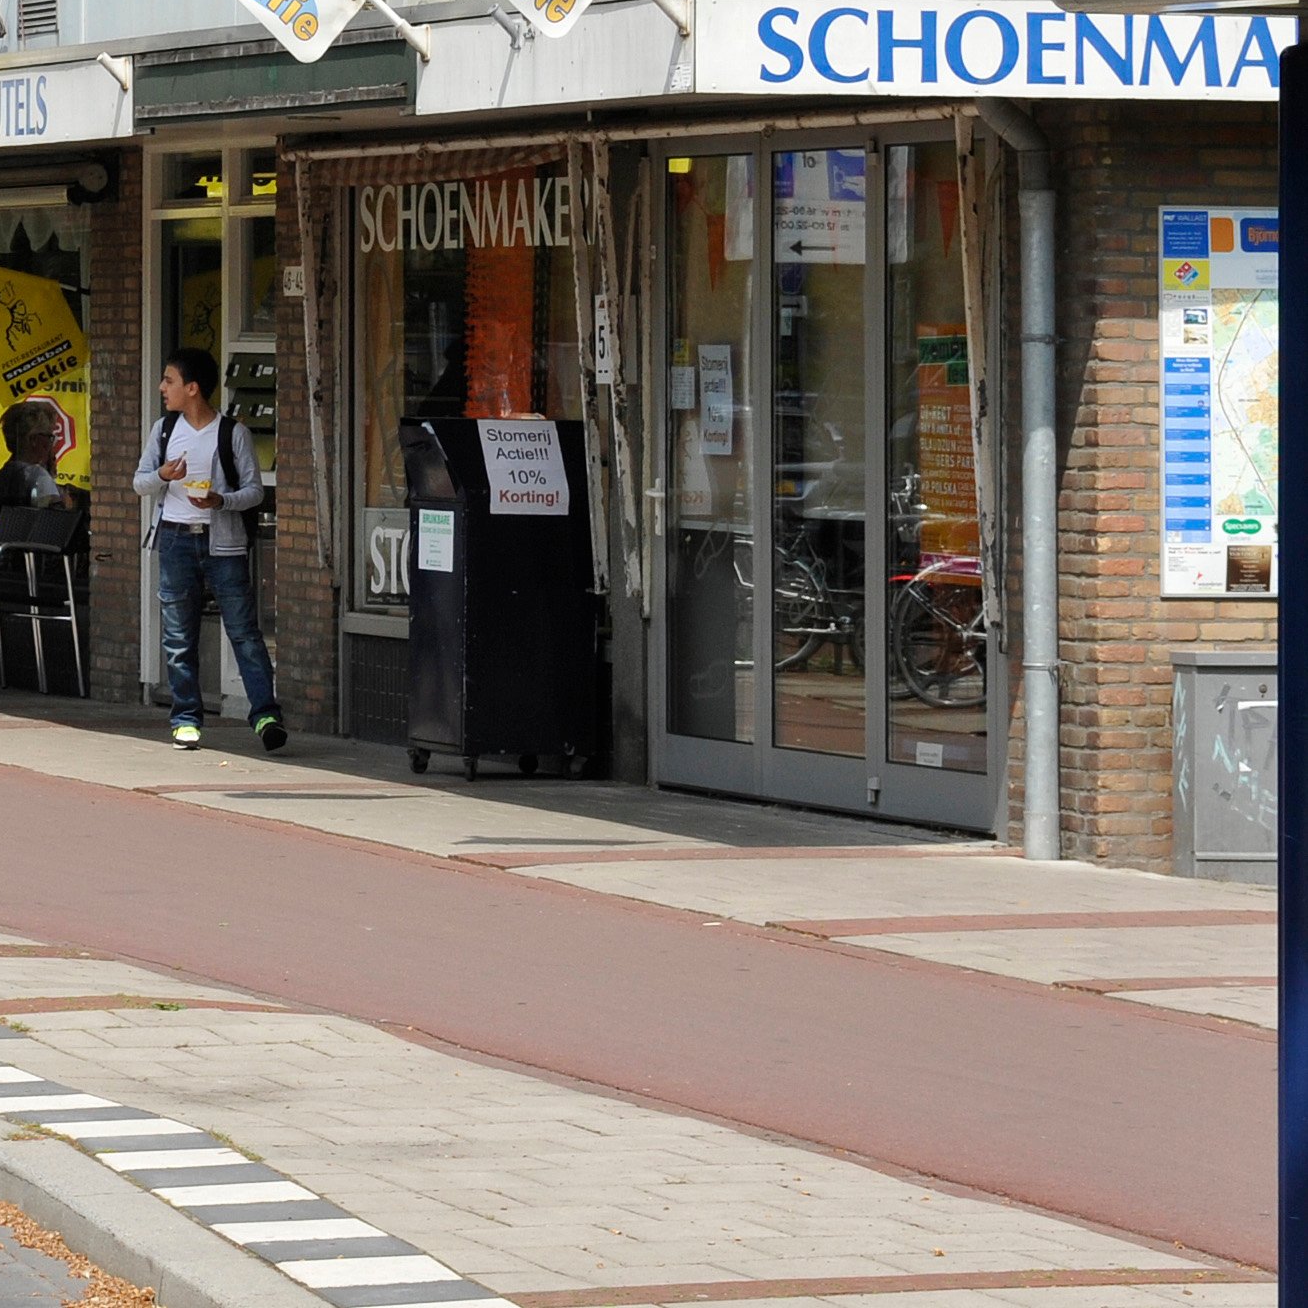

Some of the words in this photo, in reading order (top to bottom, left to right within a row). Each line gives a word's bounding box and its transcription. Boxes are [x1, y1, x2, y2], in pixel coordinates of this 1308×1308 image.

[757, 7, 1284, 87] SCHOENMA
[4, 341, 71, 380] snackbar
[9, 354, 79, 397] Kockie
[487, 429, 551, 445] Stomerij
[496, 448, 549, 460] Actie!!!
[508, 470, 547, 485] 10%
[499, 490, 559, 506] Korting!
